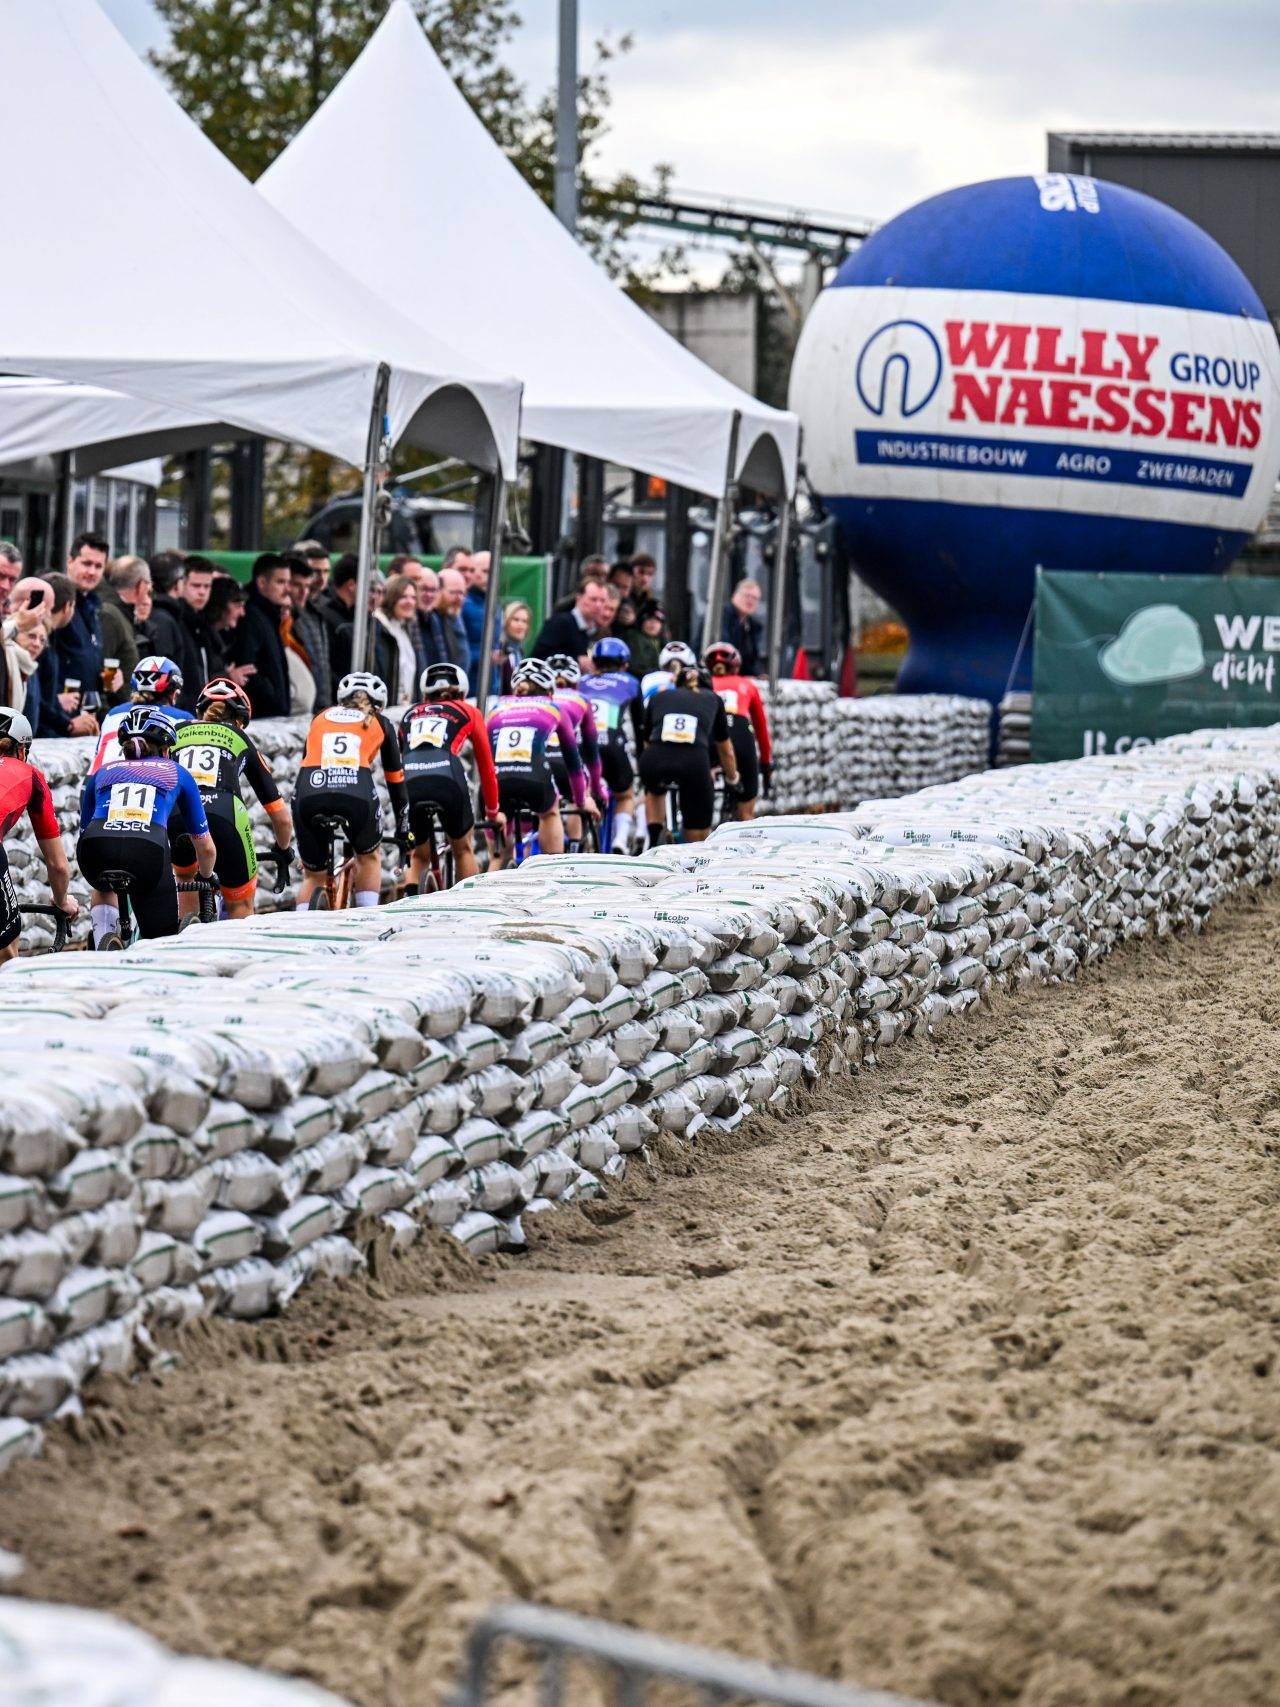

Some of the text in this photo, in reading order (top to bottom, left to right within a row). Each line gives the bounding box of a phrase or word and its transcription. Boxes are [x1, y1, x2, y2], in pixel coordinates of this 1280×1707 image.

[944, 320, 1260, 391] WILLY GROUP
[948, 374, 1262, 450] NAESSENS
[877, 439, 1235, 489] INDUSTRIEBOUW AGRO ZWEMBADEN
[417, 720, 442, 733] 17
[674, 717, 686, 731] 8
[177, 730, 234, 745] Valkenburg
[332, 735, 348, 754] 5
[509, 730, 521, 747] 9
[184, 749, 215, 771] 13
[118, 786, 148, 808] 11
[103, 821, 151, 832] essec
